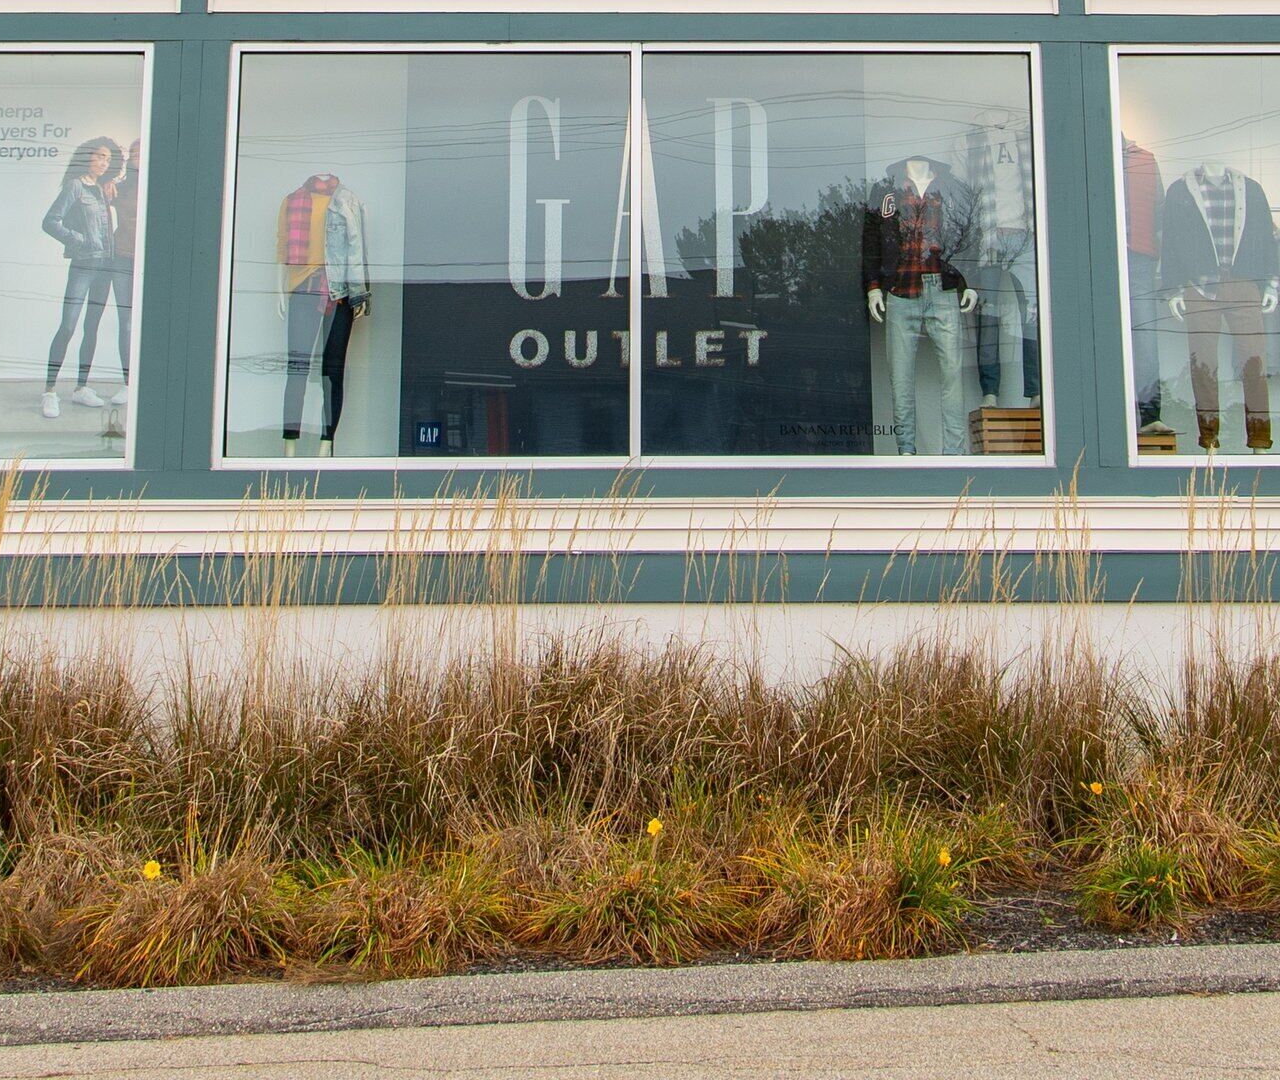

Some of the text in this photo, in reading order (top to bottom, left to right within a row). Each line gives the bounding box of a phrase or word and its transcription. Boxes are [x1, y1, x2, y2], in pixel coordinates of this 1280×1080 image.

[43, 124, 72, 138] For
[508, 95, 768, 301] GAP
[509, 328, 768, 368] OUTLET
[420, 427, 439, 443] GAP
[780, 424, 905, 436] BANANA REPUBLIC
